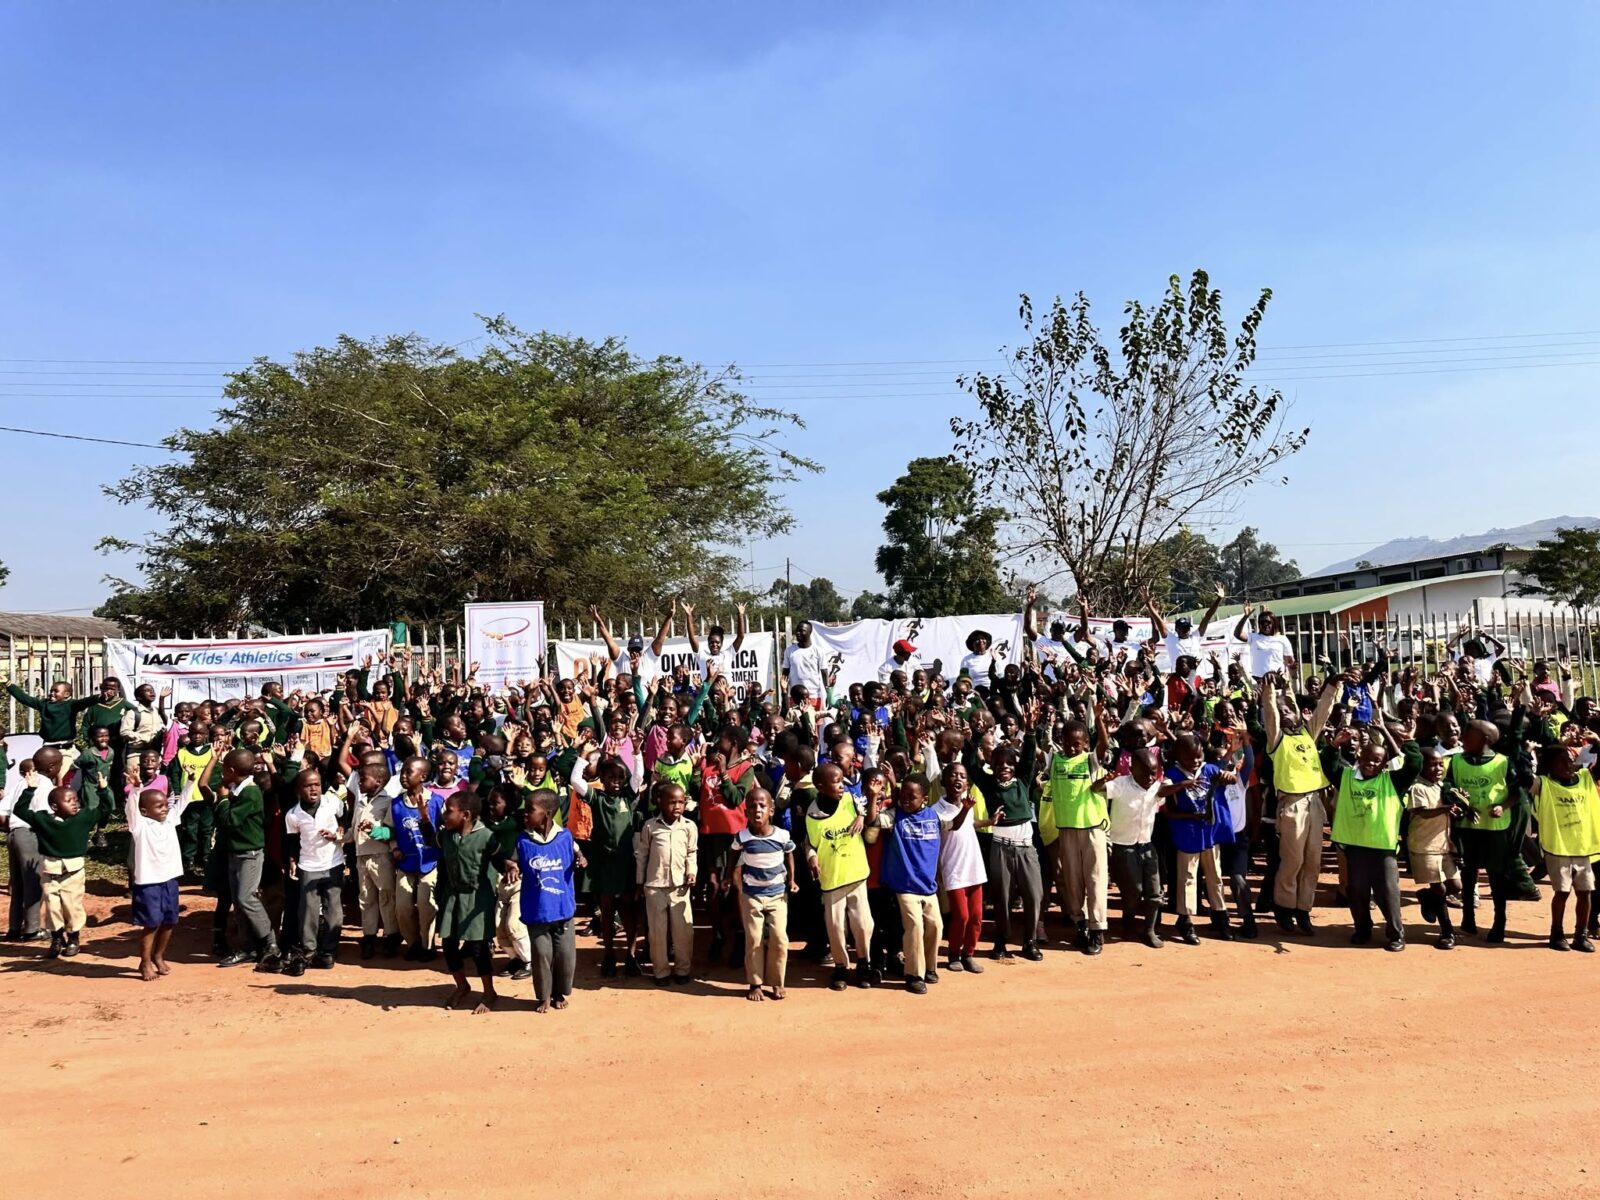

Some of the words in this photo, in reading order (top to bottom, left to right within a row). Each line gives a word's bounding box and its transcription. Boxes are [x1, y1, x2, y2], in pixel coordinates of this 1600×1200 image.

[142, 653, 190, 666] IAAF
[188, 651, 228, 666] Kids'
[230, 649, 294, 664] Athletics
